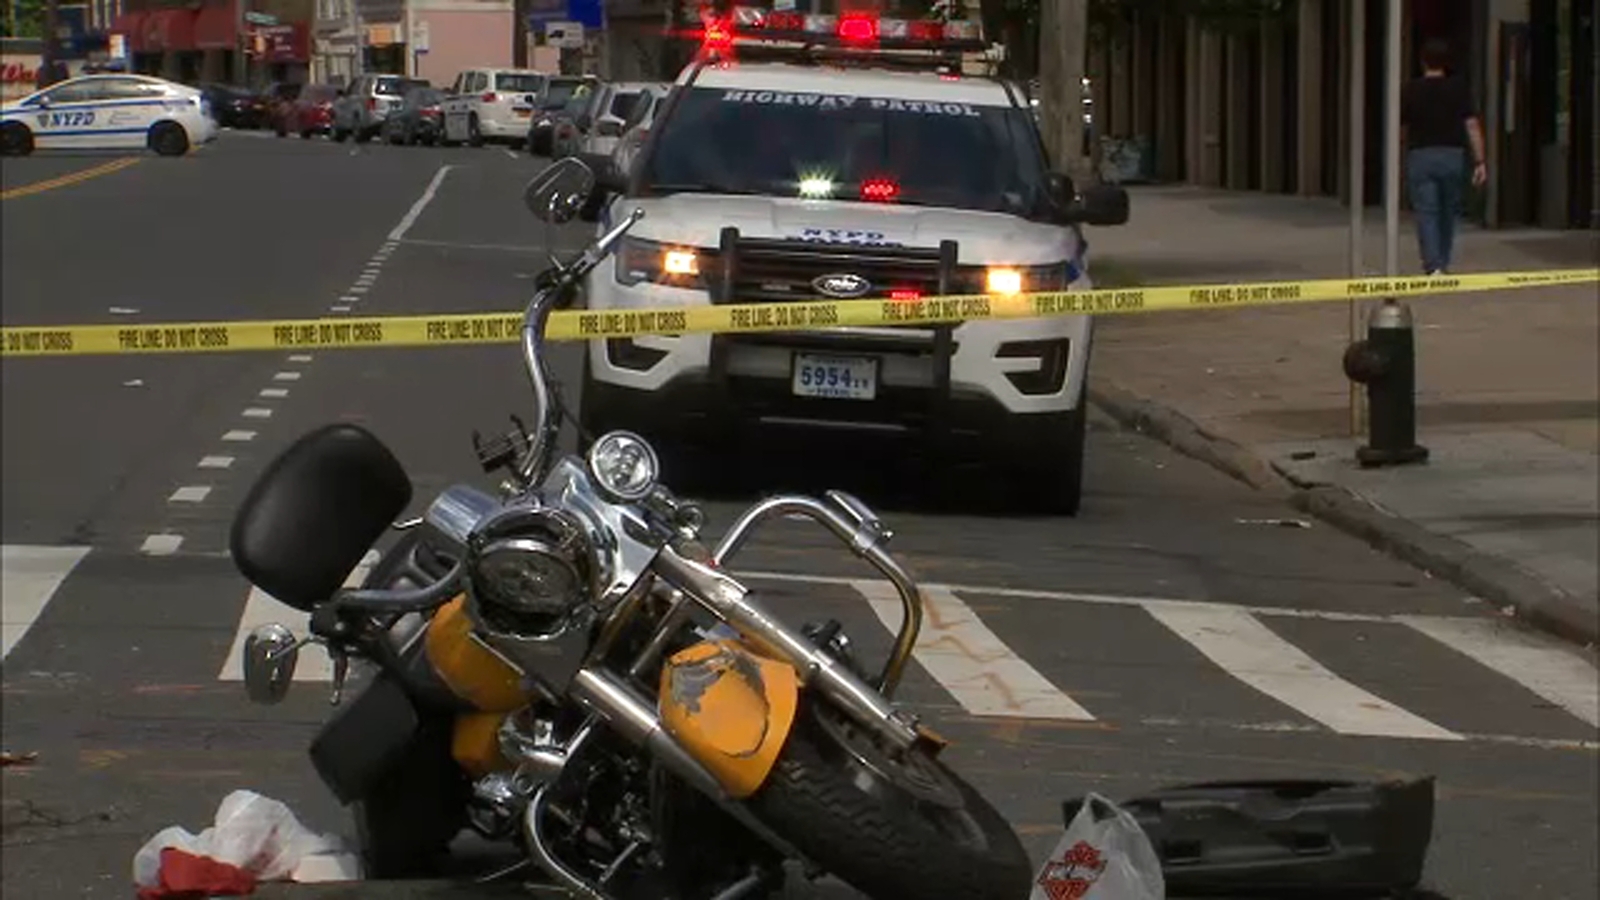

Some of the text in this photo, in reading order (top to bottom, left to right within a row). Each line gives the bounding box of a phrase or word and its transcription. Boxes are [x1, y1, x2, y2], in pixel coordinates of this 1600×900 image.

[722, 90, 981, 116] HIGHWAY PATROL
[51, 112, 95, 126] NYPD
[800, 229, 884, 240] NYPD
[1036, 296, 1055, 314] FIRE
[1081, 294, 1093, 310] DO
[1095, 293, 1112, 310] NOT
[1115, 291, 1143, 308] CROSS
[1190, 289, 1210, 303] FIRE
[1237, 287, 1249, 301] DO
[1251, 287, 1268, 300] NOT
[731, 308, 751, 327] FIRE
[775, 306, 788, 325] DO
[790, 306, 807, 325] NOT
[809, 305, 838, 324] CROSS
[882, 302, 902, 320] FIRE
[928, 301, 940, 318] DO
[942, 299, 959, 317] NOT
[962, 298, 990, 317] CROSS
[427, 321, 446, 339] FIRE
[472, 319, 484, 338] DO
[486, 318, 503, 337] NOT
[505, 317, 521, 336] CRO
[579, 314, 598, 333] FIRE
[624, 313, 636, 332] DO
[638, 312, 655, 331] NOT
[657, 310, 686, 330] CROSS
[7, 332, 20, 350] DO
[22, 332, 40, 350] NOT
[42, 331, 73, 350] CROSS
[119, 329, 139, 349] FIRE
[164, 328, 177, 348] DO
[179, 327, 196, 347] NOT
[198, 326, 228, 346] CROSS
[273, 325, 293, 344] FIRE
[319, 324, 332, 343] DO
[333, 323, 351, 342] NOT
[353, 322, 382, 341] CROSS
[801, 366, 851, 387] 5954
